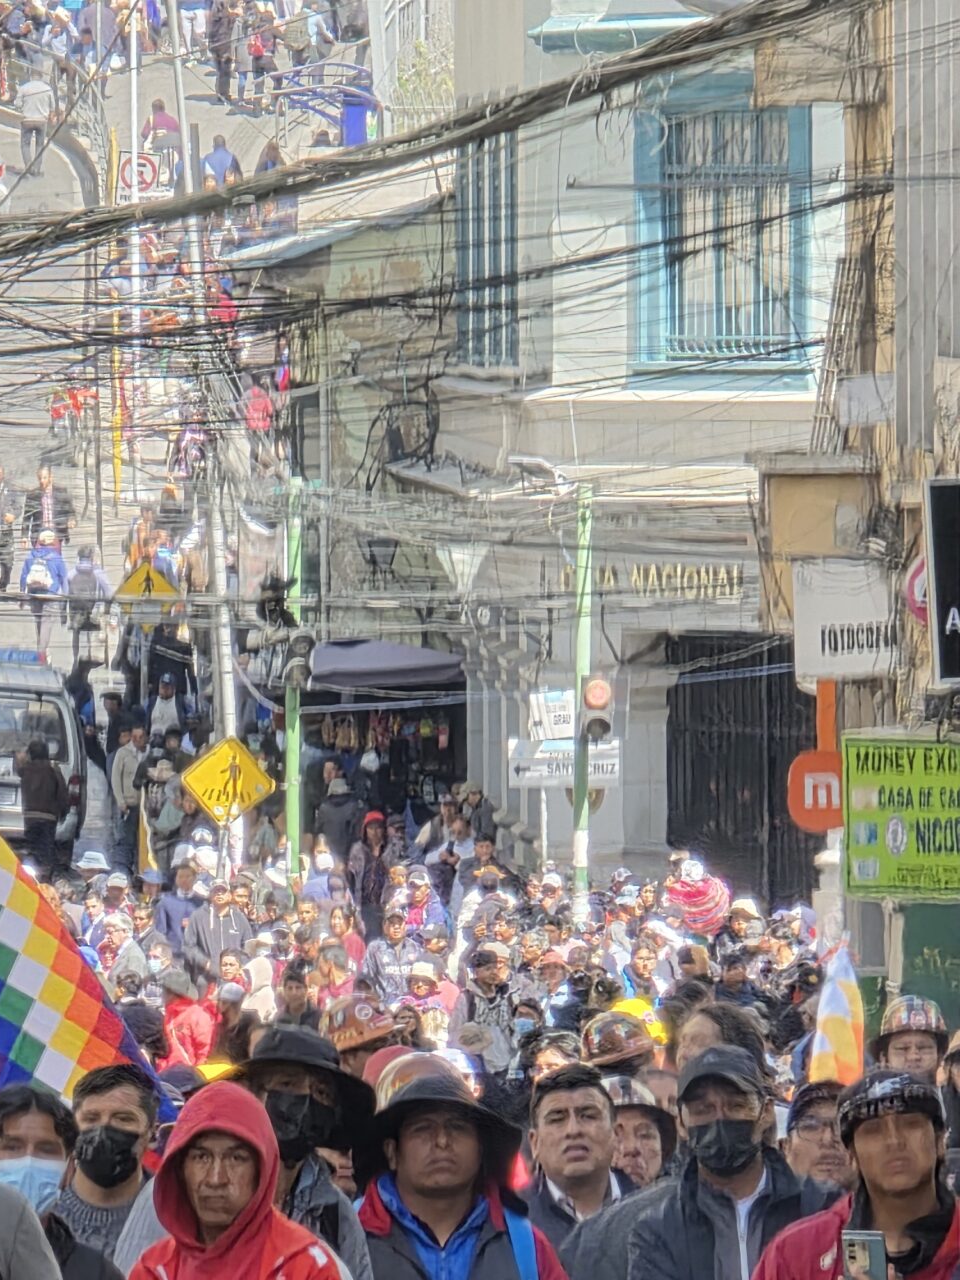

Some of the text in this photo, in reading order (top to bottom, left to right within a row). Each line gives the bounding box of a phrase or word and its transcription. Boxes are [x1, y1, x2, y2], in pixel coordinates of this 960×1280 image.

[631, 562, 742, 599] NACIONAL
[856, 746, 916, 774] MONEY
[878, 785, 914, 810] CASA
